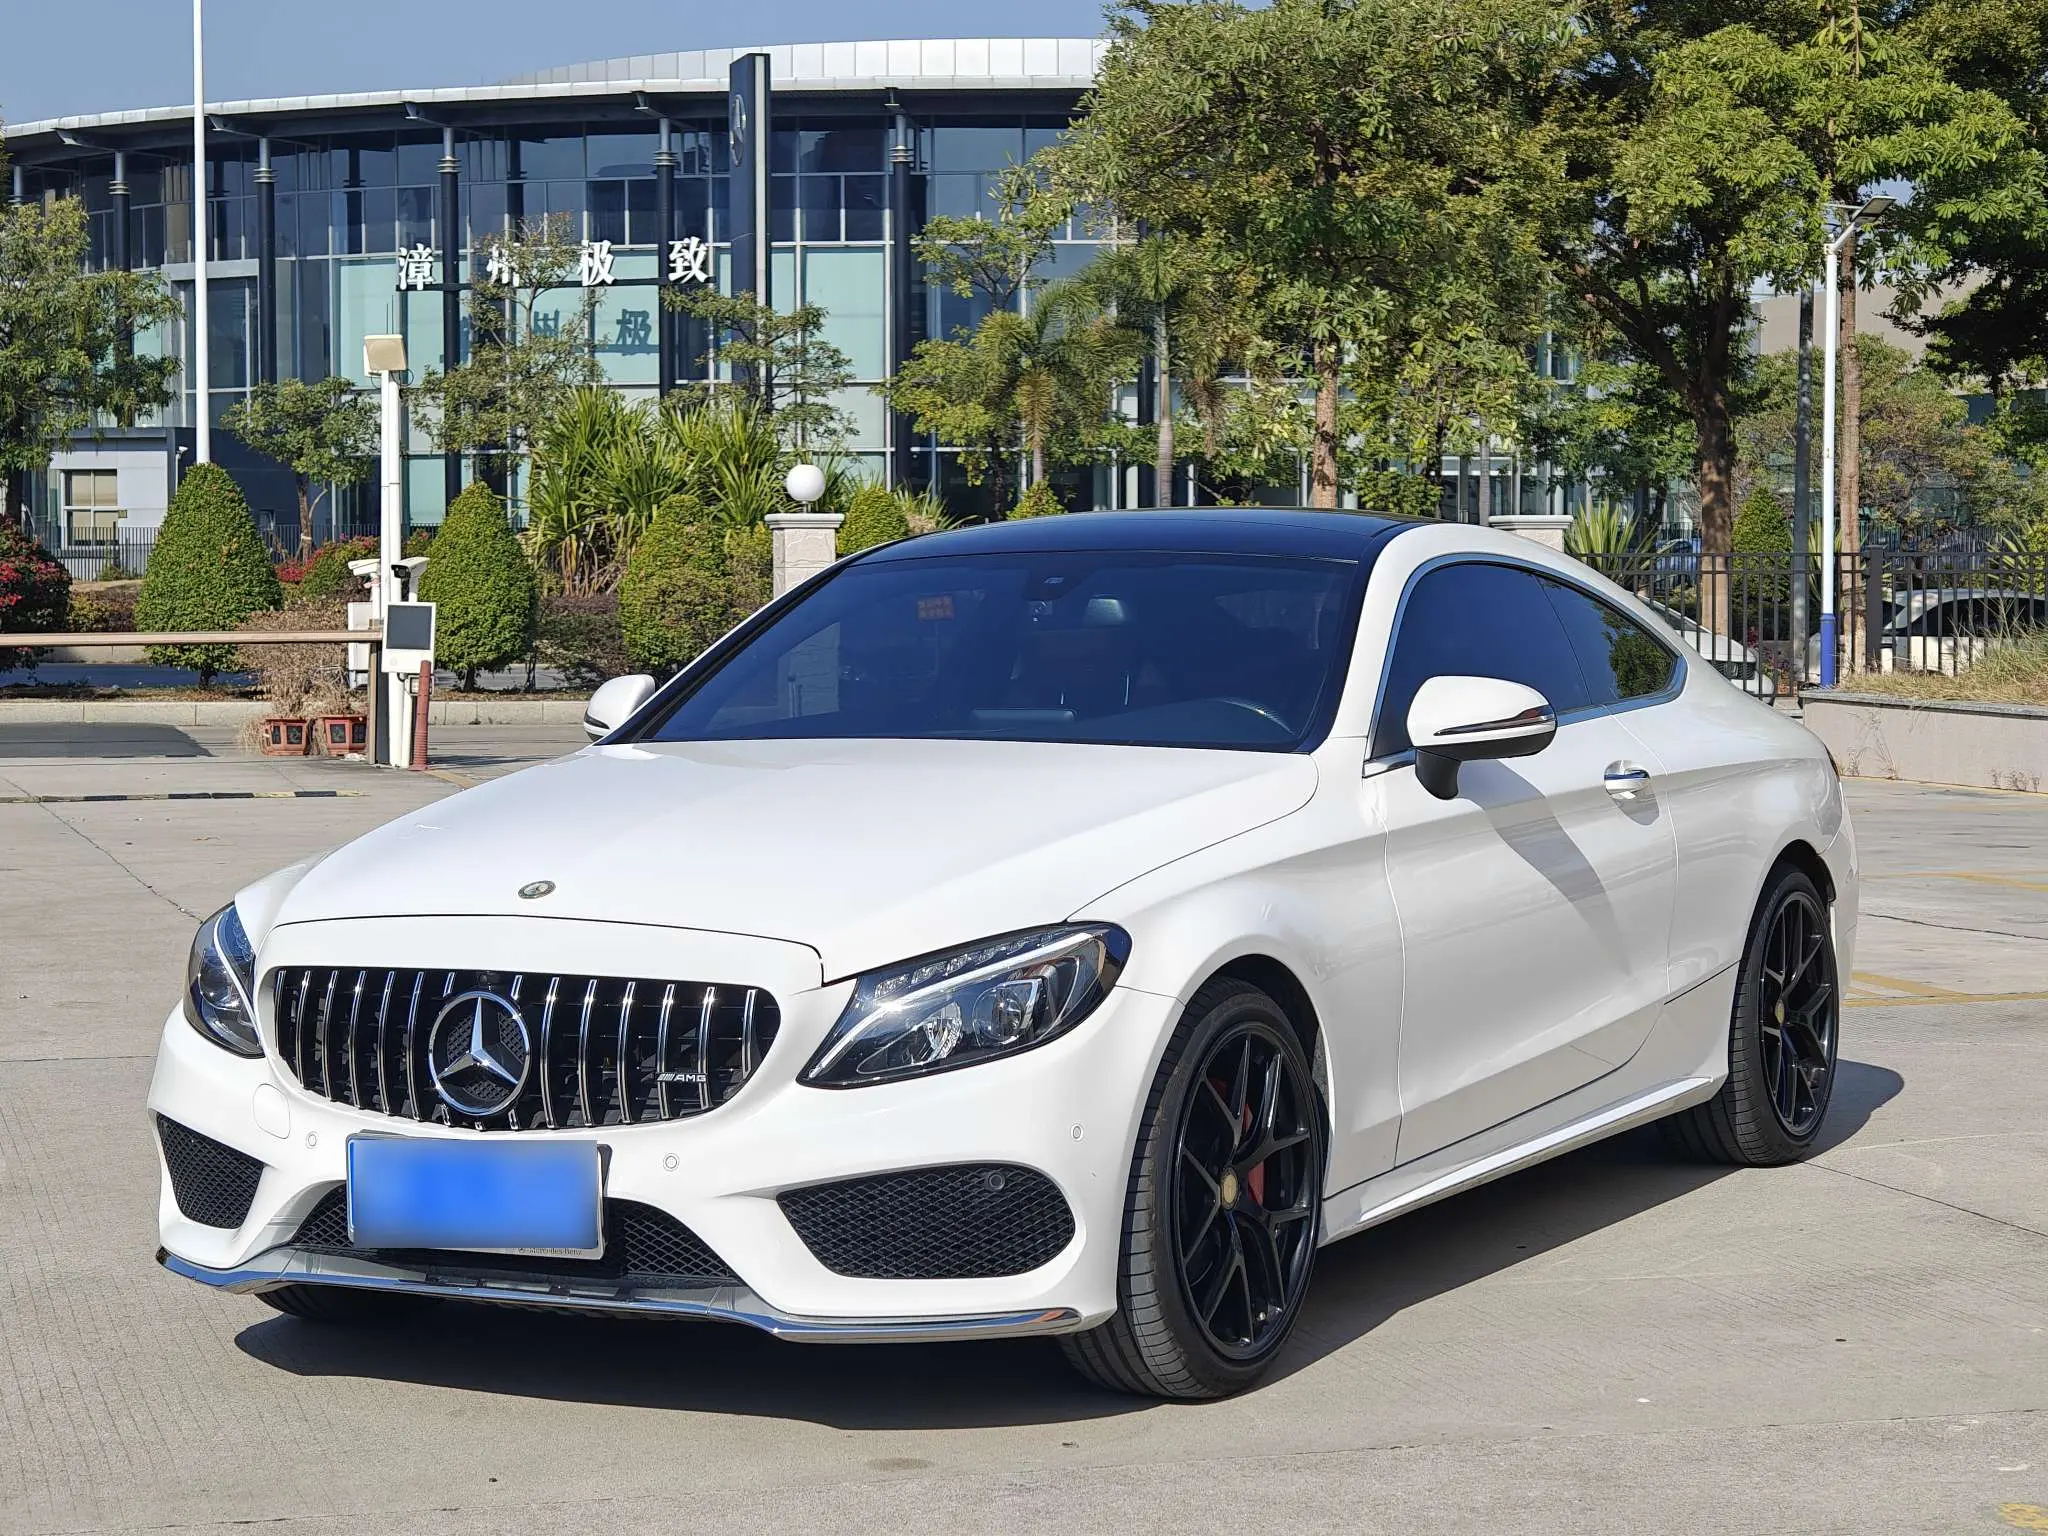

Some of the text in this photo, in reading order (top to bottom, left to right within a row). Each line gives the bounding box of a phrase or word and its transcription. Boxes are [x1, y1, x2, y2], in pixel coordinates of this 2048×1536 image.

[399, 236, 709, 291] 漳州极致
[672, 1074, 707, 1083] AMG
